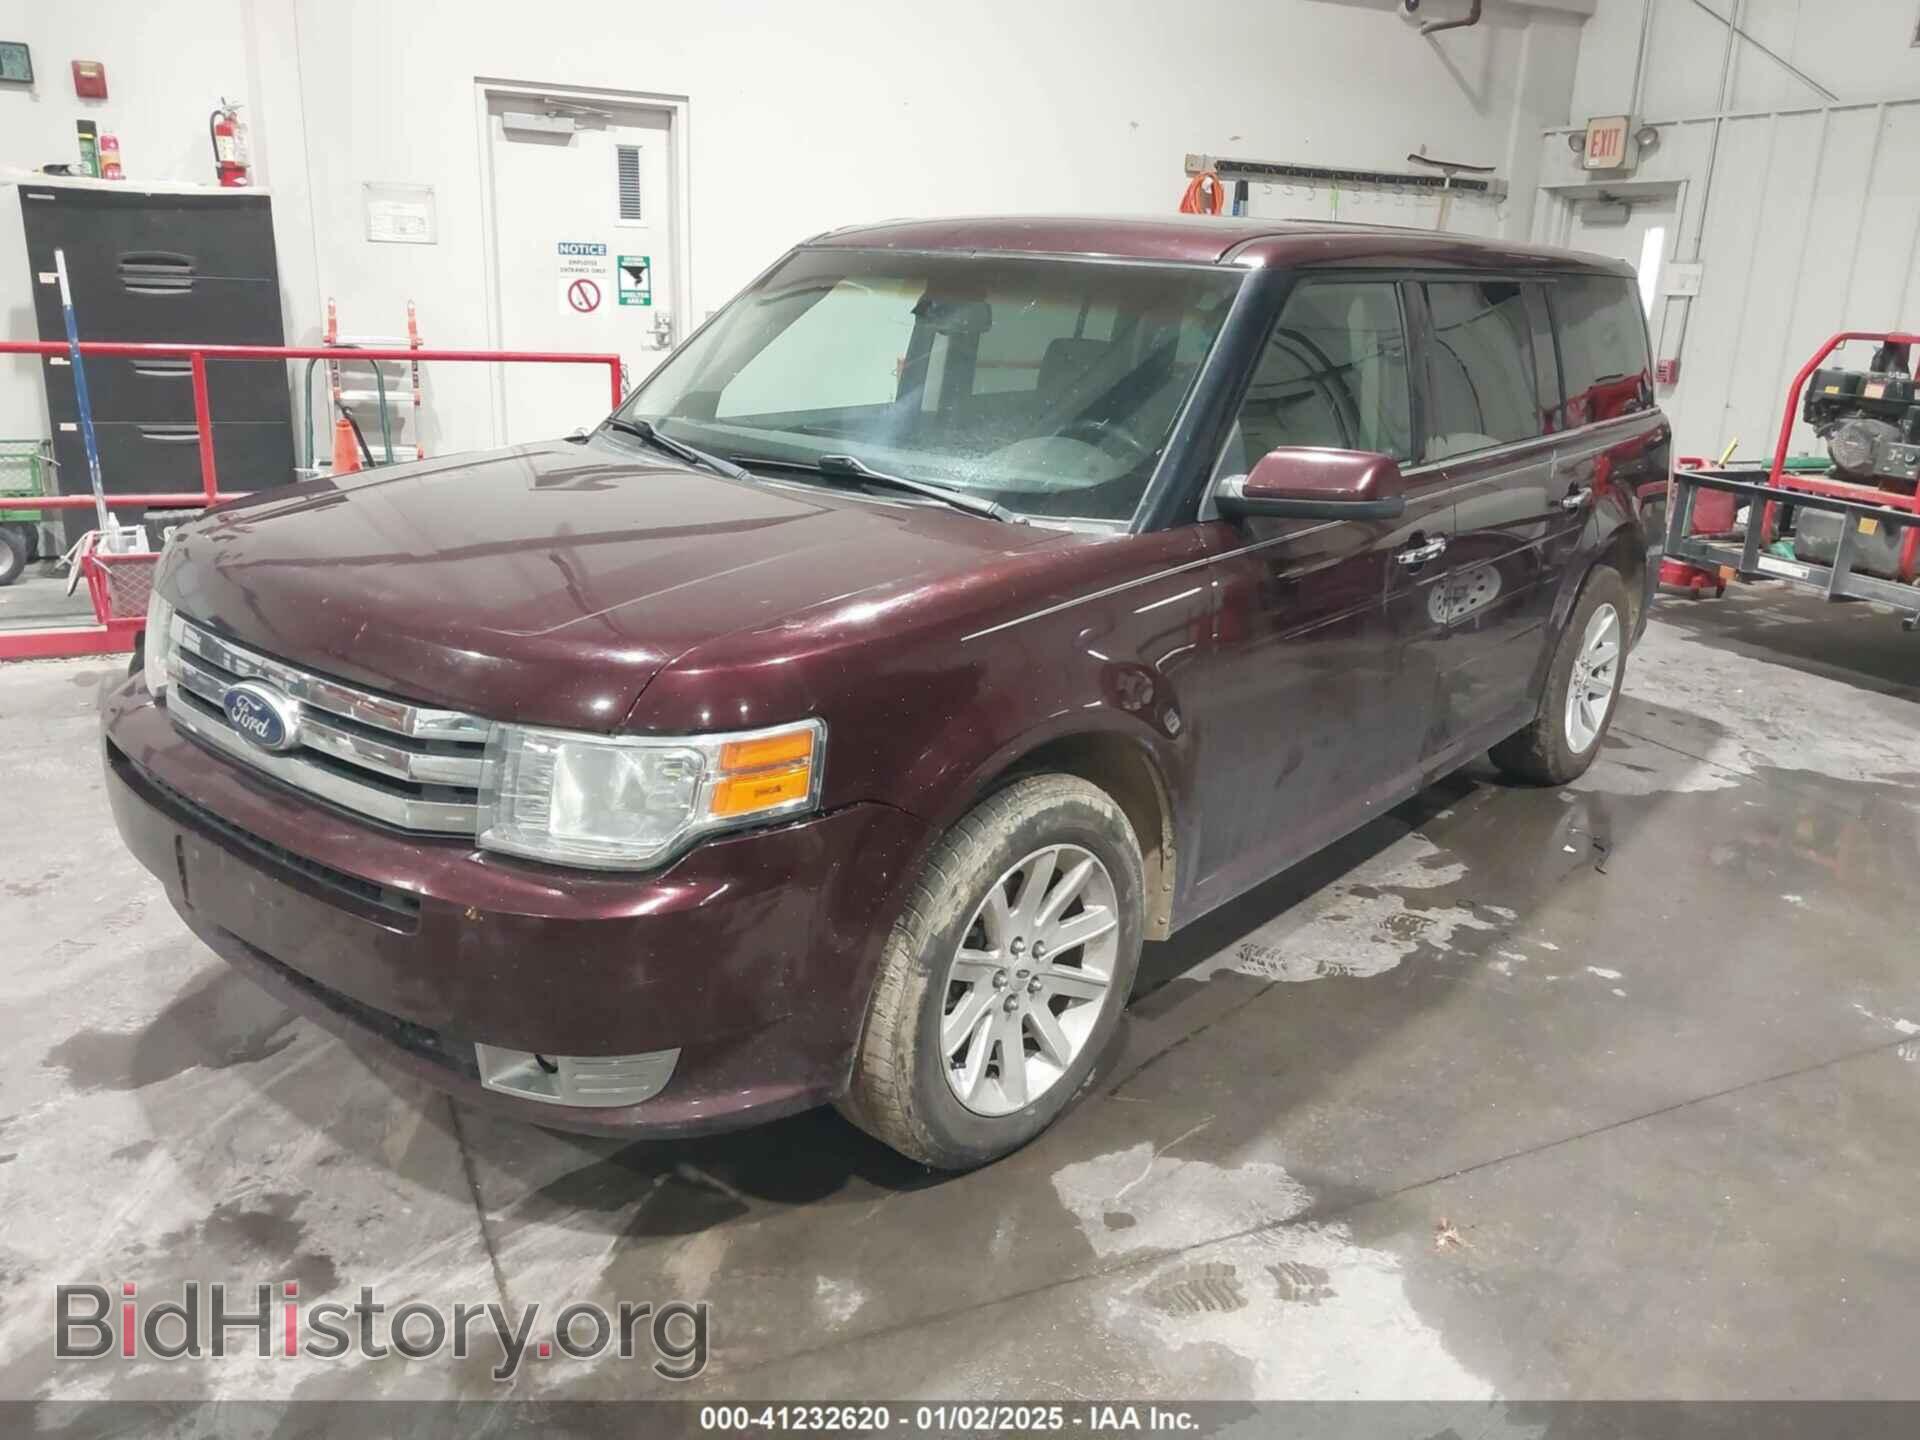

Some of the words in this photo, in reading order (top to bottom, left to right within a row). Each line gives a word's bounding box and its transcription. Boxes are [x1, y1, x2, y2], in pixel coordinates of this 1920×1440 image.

[1590, 129, 1621, 157] EXIT
[559, 243, 606, 255] NOTICE
[231, 695, 270, 737] Ford
